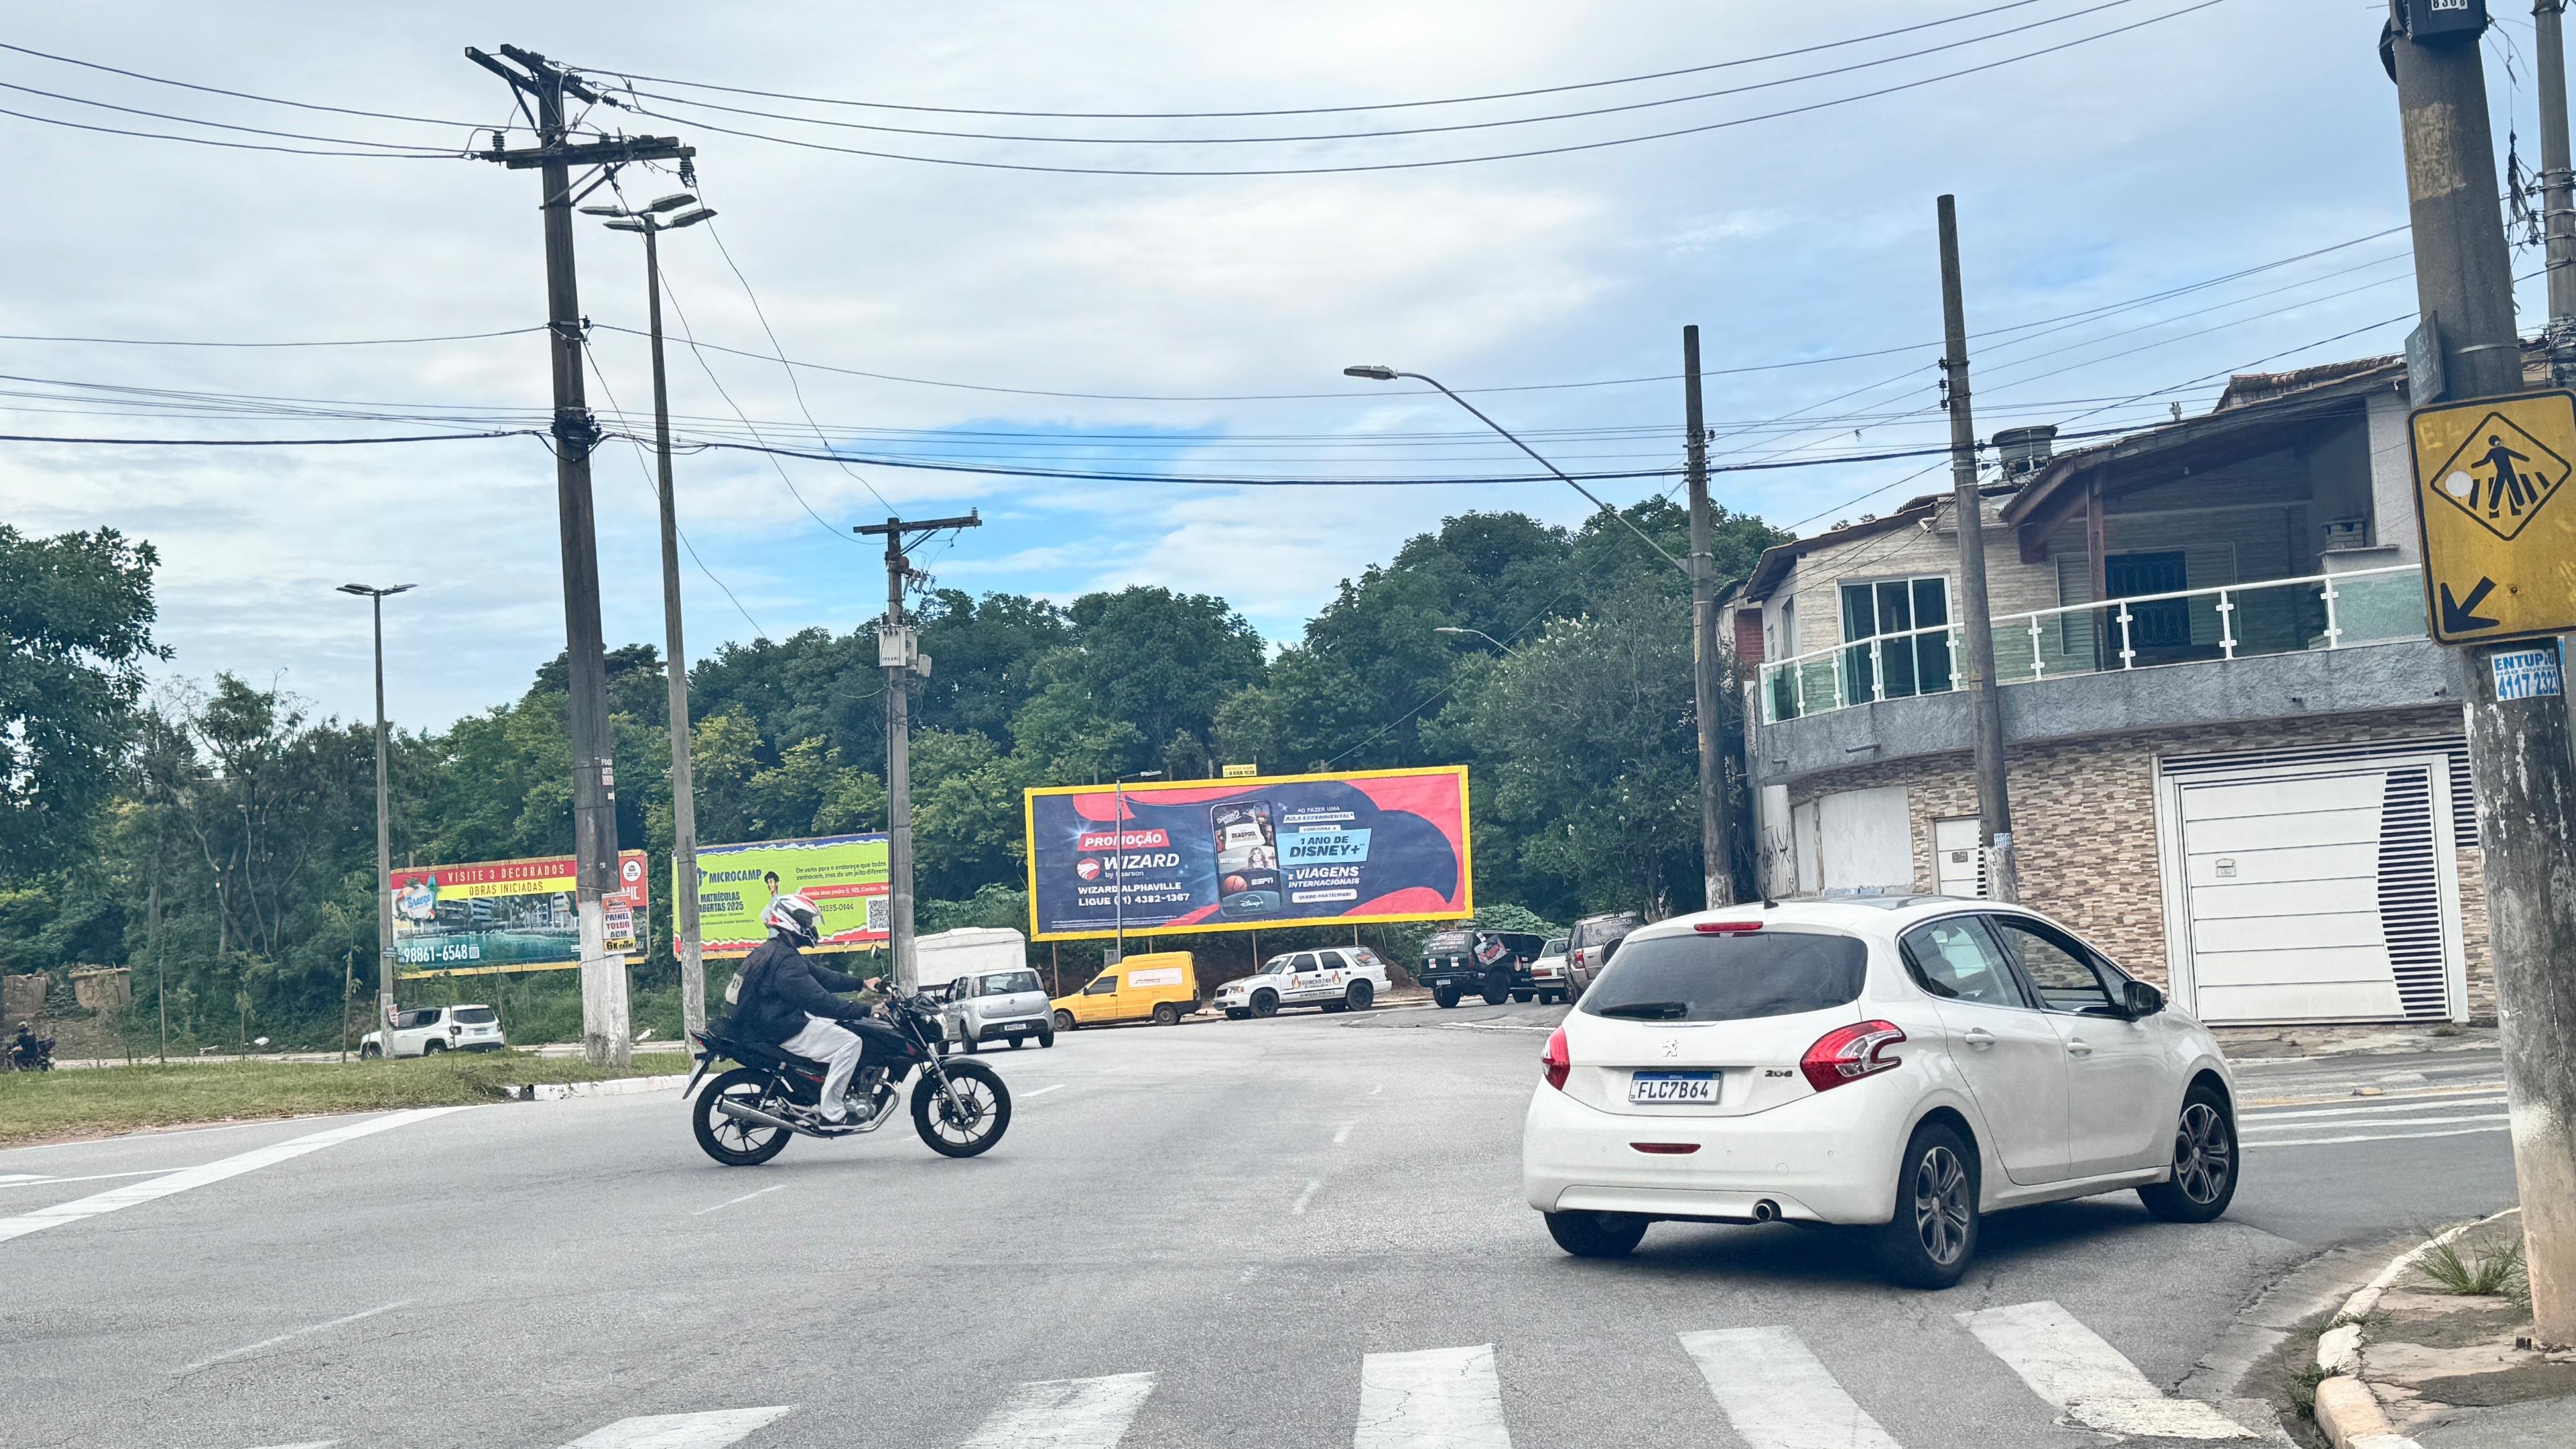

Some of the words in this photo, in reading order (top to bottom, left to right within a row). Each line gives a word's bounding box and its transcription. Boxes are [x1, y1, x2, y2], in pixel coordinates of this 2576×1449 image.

[2499, 673, 2530, 700] 4117
[1307, 837, 1331, 845] ANO
[448, 870, 483, 883] VISITE
[489, 869, 495, 879] 3
[502, 864, 565, 879] DECORADOS
[709, 869, 762, 884] MICROCAMP
[1251, 877, 1273, 886] ESPN
[1288, 878, 1360, 888] INTERNACIONAIS
[469, 885, 497, 896] OBRAS
[500, 881, 543, 893] INICIADAS
[1077, 886, 1118, 895] WIZARD
[1121, 882, 1181, 892] ALPHAVILLE
[700, 892, 740, 903] MATRÍCULAS
[1078, 897, 1111, 906] LIGUE
[1114, 895, 1131, 906] (1)
[1134, 893, 1190, 904] 4382-1367
[727, 901, 744, 911] 2025
[605, 912, 630, 921] PAINEL
[606, 921, 630, 929] TOLDO
[404, 944, 468, 963] 98861-6548
[1638, 1081, 1708, 1099] FLC7B64
